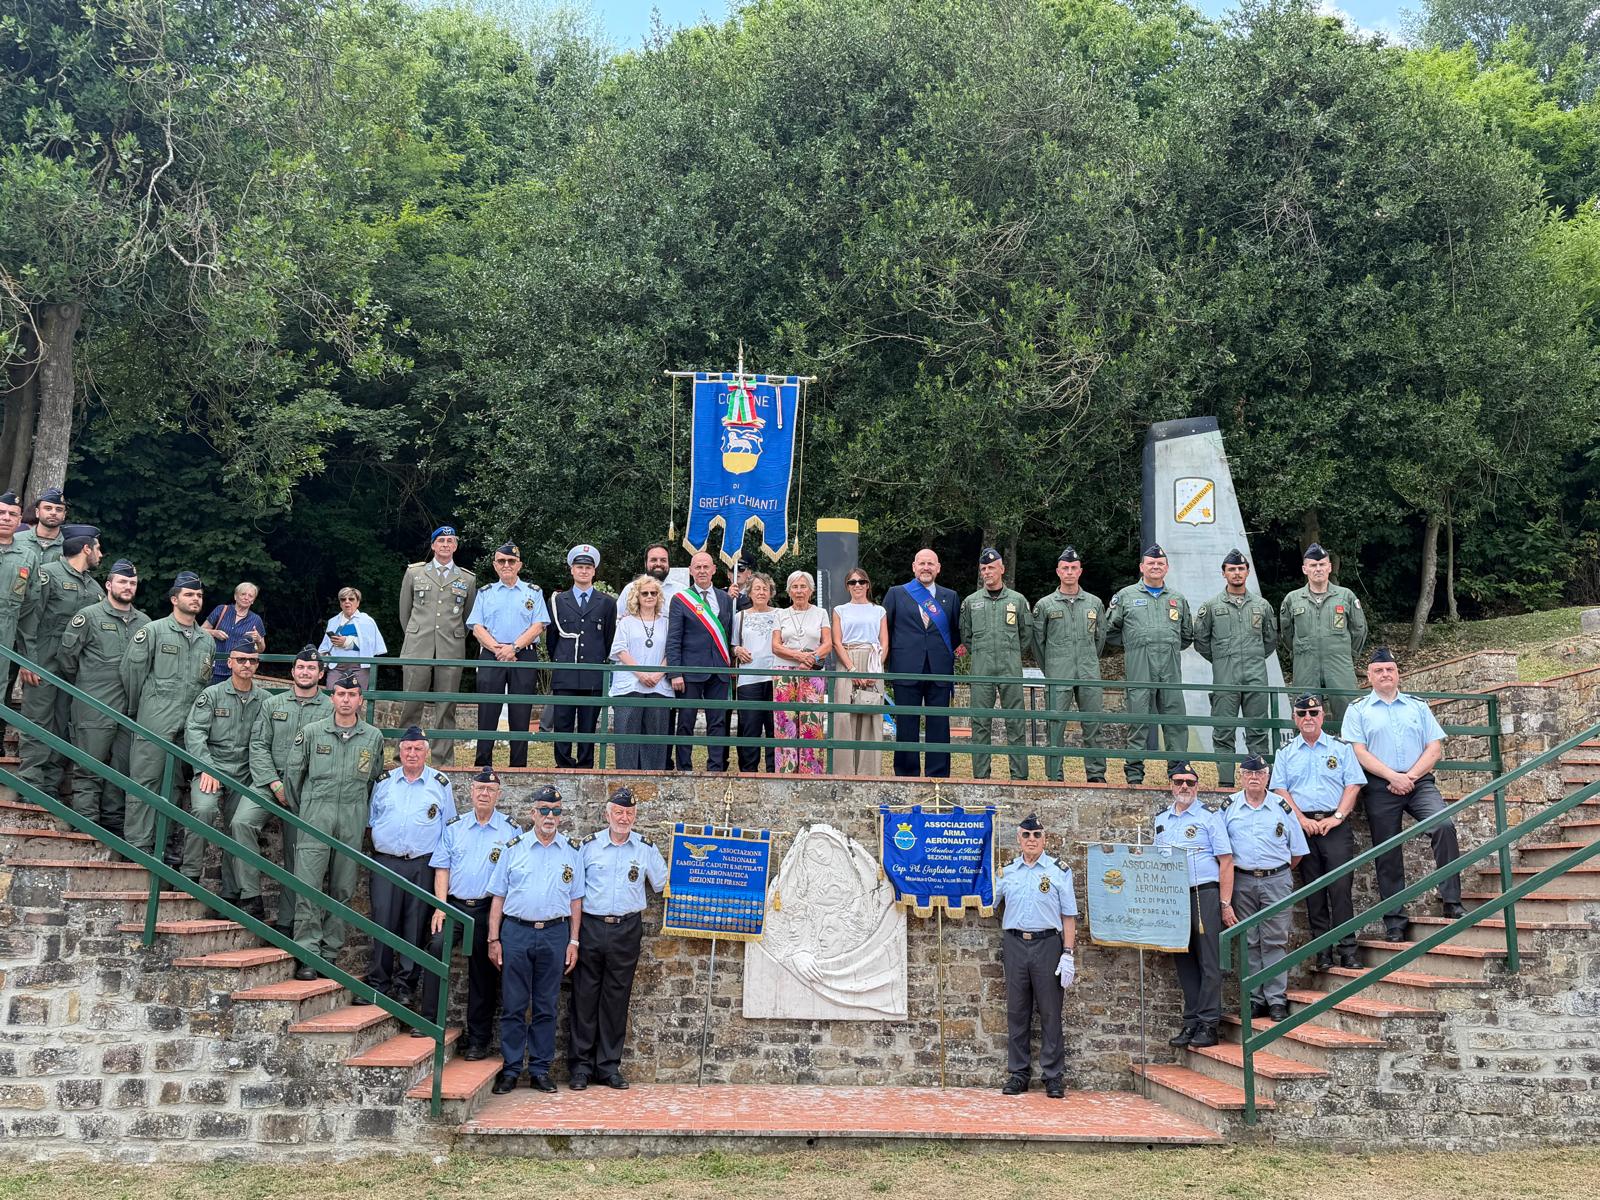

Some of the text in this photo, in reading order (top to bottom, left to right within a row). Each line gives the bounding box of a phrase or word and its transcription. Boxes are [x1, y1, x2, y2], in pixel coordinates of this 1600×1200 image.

[718, 393, 770, 407] CONE
[699, 495, 729, 508] GREVE
[738, 494, 778, 510] CHIANTI
[924, 821, 985, 829] ASSOCIAZIONE
[943, 829, 967, 837] ARMA
[925, 837, 984, 845] AERONAUTICA
[719, 848, 762, 857] ASSOCIAZIONE
[722, 855, 757, 864] NAZIONALE
[1122, 859, 1184, 871] ASSOCIAZIONE
[676, 859, 705, 867] FAMIGLIE
[705, 861, 730, 869] CADUTI
[734, 864, 764, 872] MUTILATI
[921, 865, 956, 876] Guglielmo
[688, 876, 716, 884] SEZIONE
[723, 879, 748, 887] FIRENZE
[1136, 872, 1167, 884] ARMA
[1136, 884, 1184, 894] AERONAUTICA
